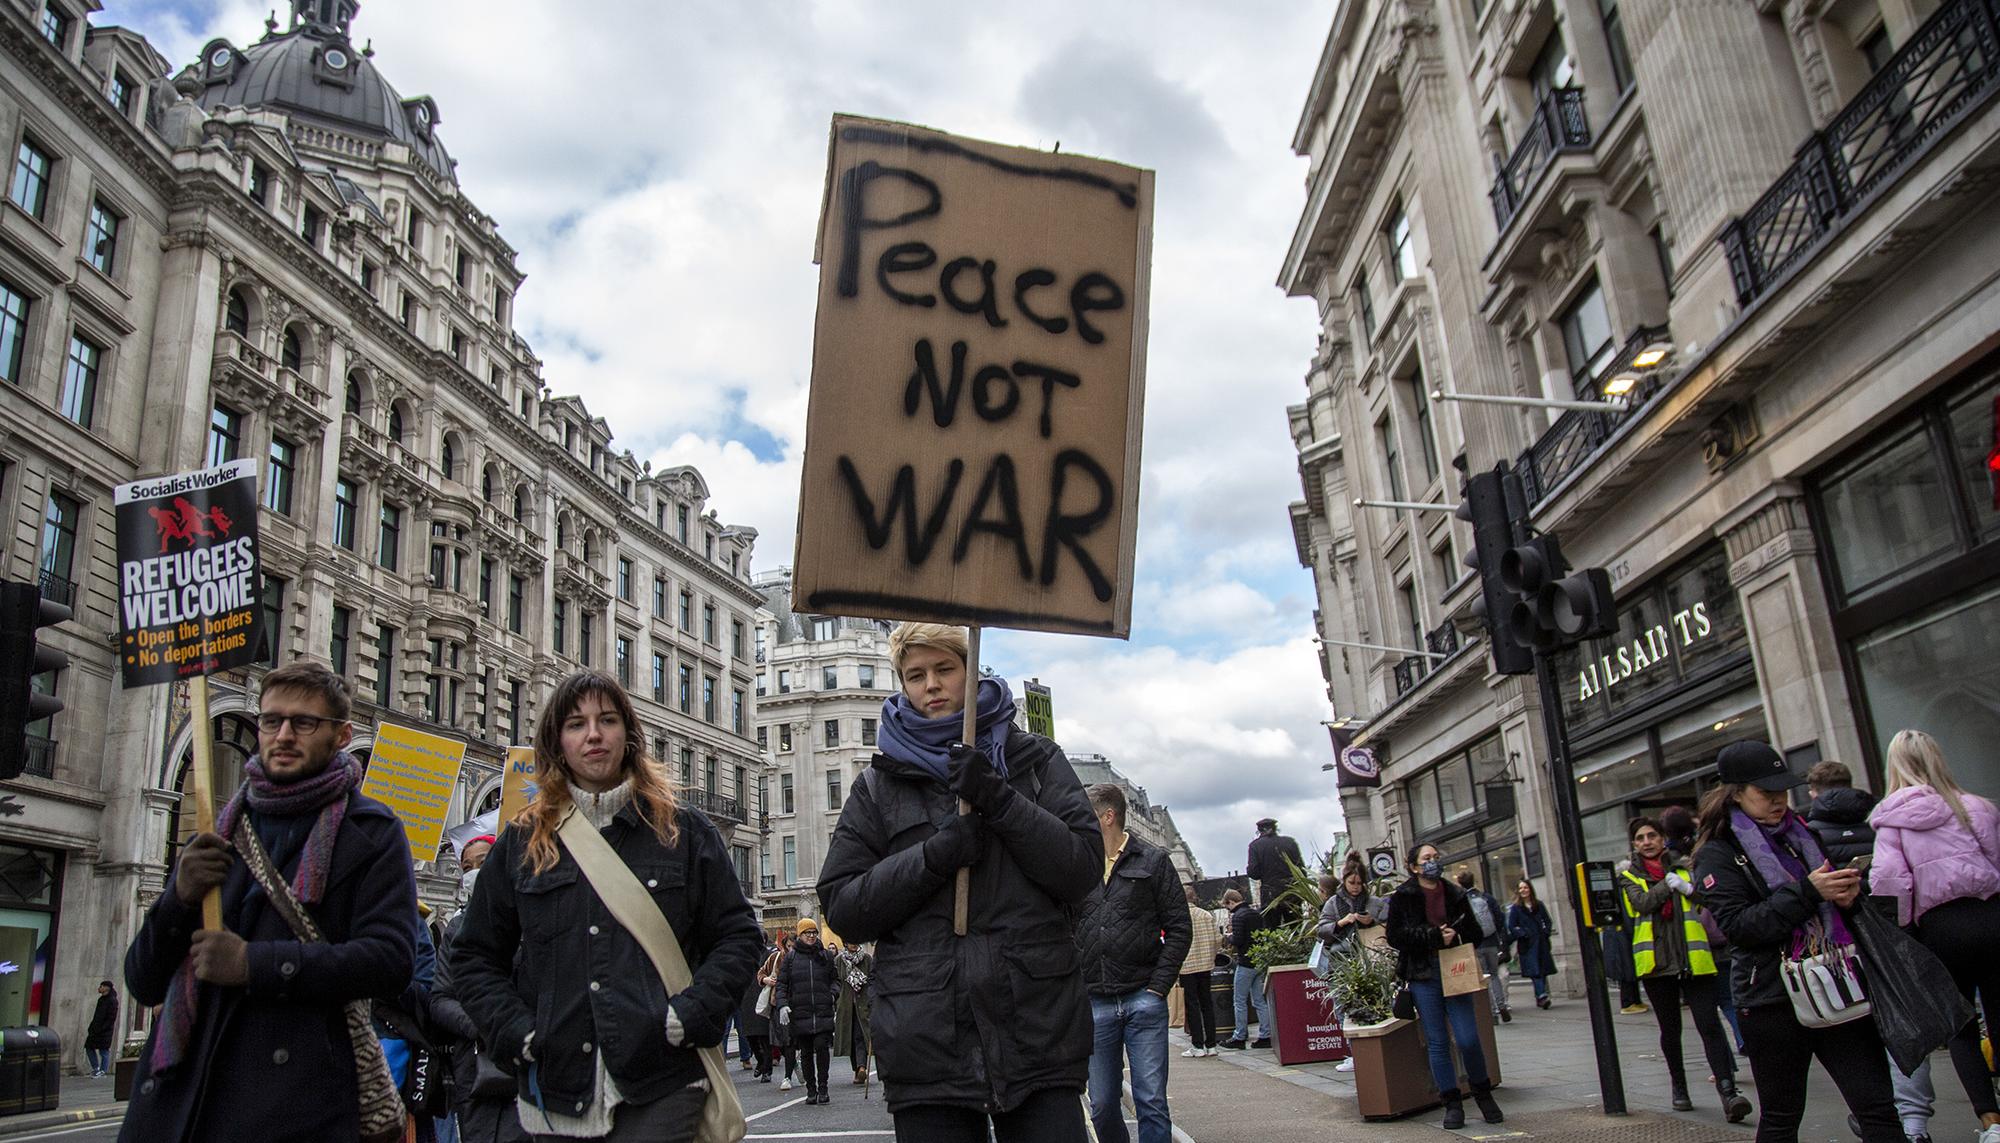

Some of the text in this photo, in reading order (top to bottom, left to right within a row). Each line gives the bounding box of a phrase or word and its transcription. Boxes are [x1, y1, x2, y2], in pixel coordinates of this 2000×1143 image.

[838, 160, 1125, 345] Peace
[904, 337, 1081, 439] NOT
[131, 467, 239, 499] Socialist Worker
[837, 448, 1113, 602] WAR
[123, 536, 254, 595] REFUGEES
[123, 571, 255, 630] WELCOME
[137, 611, 253, 648] Open the borders
[139, 632, 246, 667] No deportations
[1026, 692, 1040, 716] NO
[1306, 1023, 1338, 1033] brought
[1316, 1036, 1342, 1044] CROWN
[1317, 1042, 1342, 1050] ESTATE
